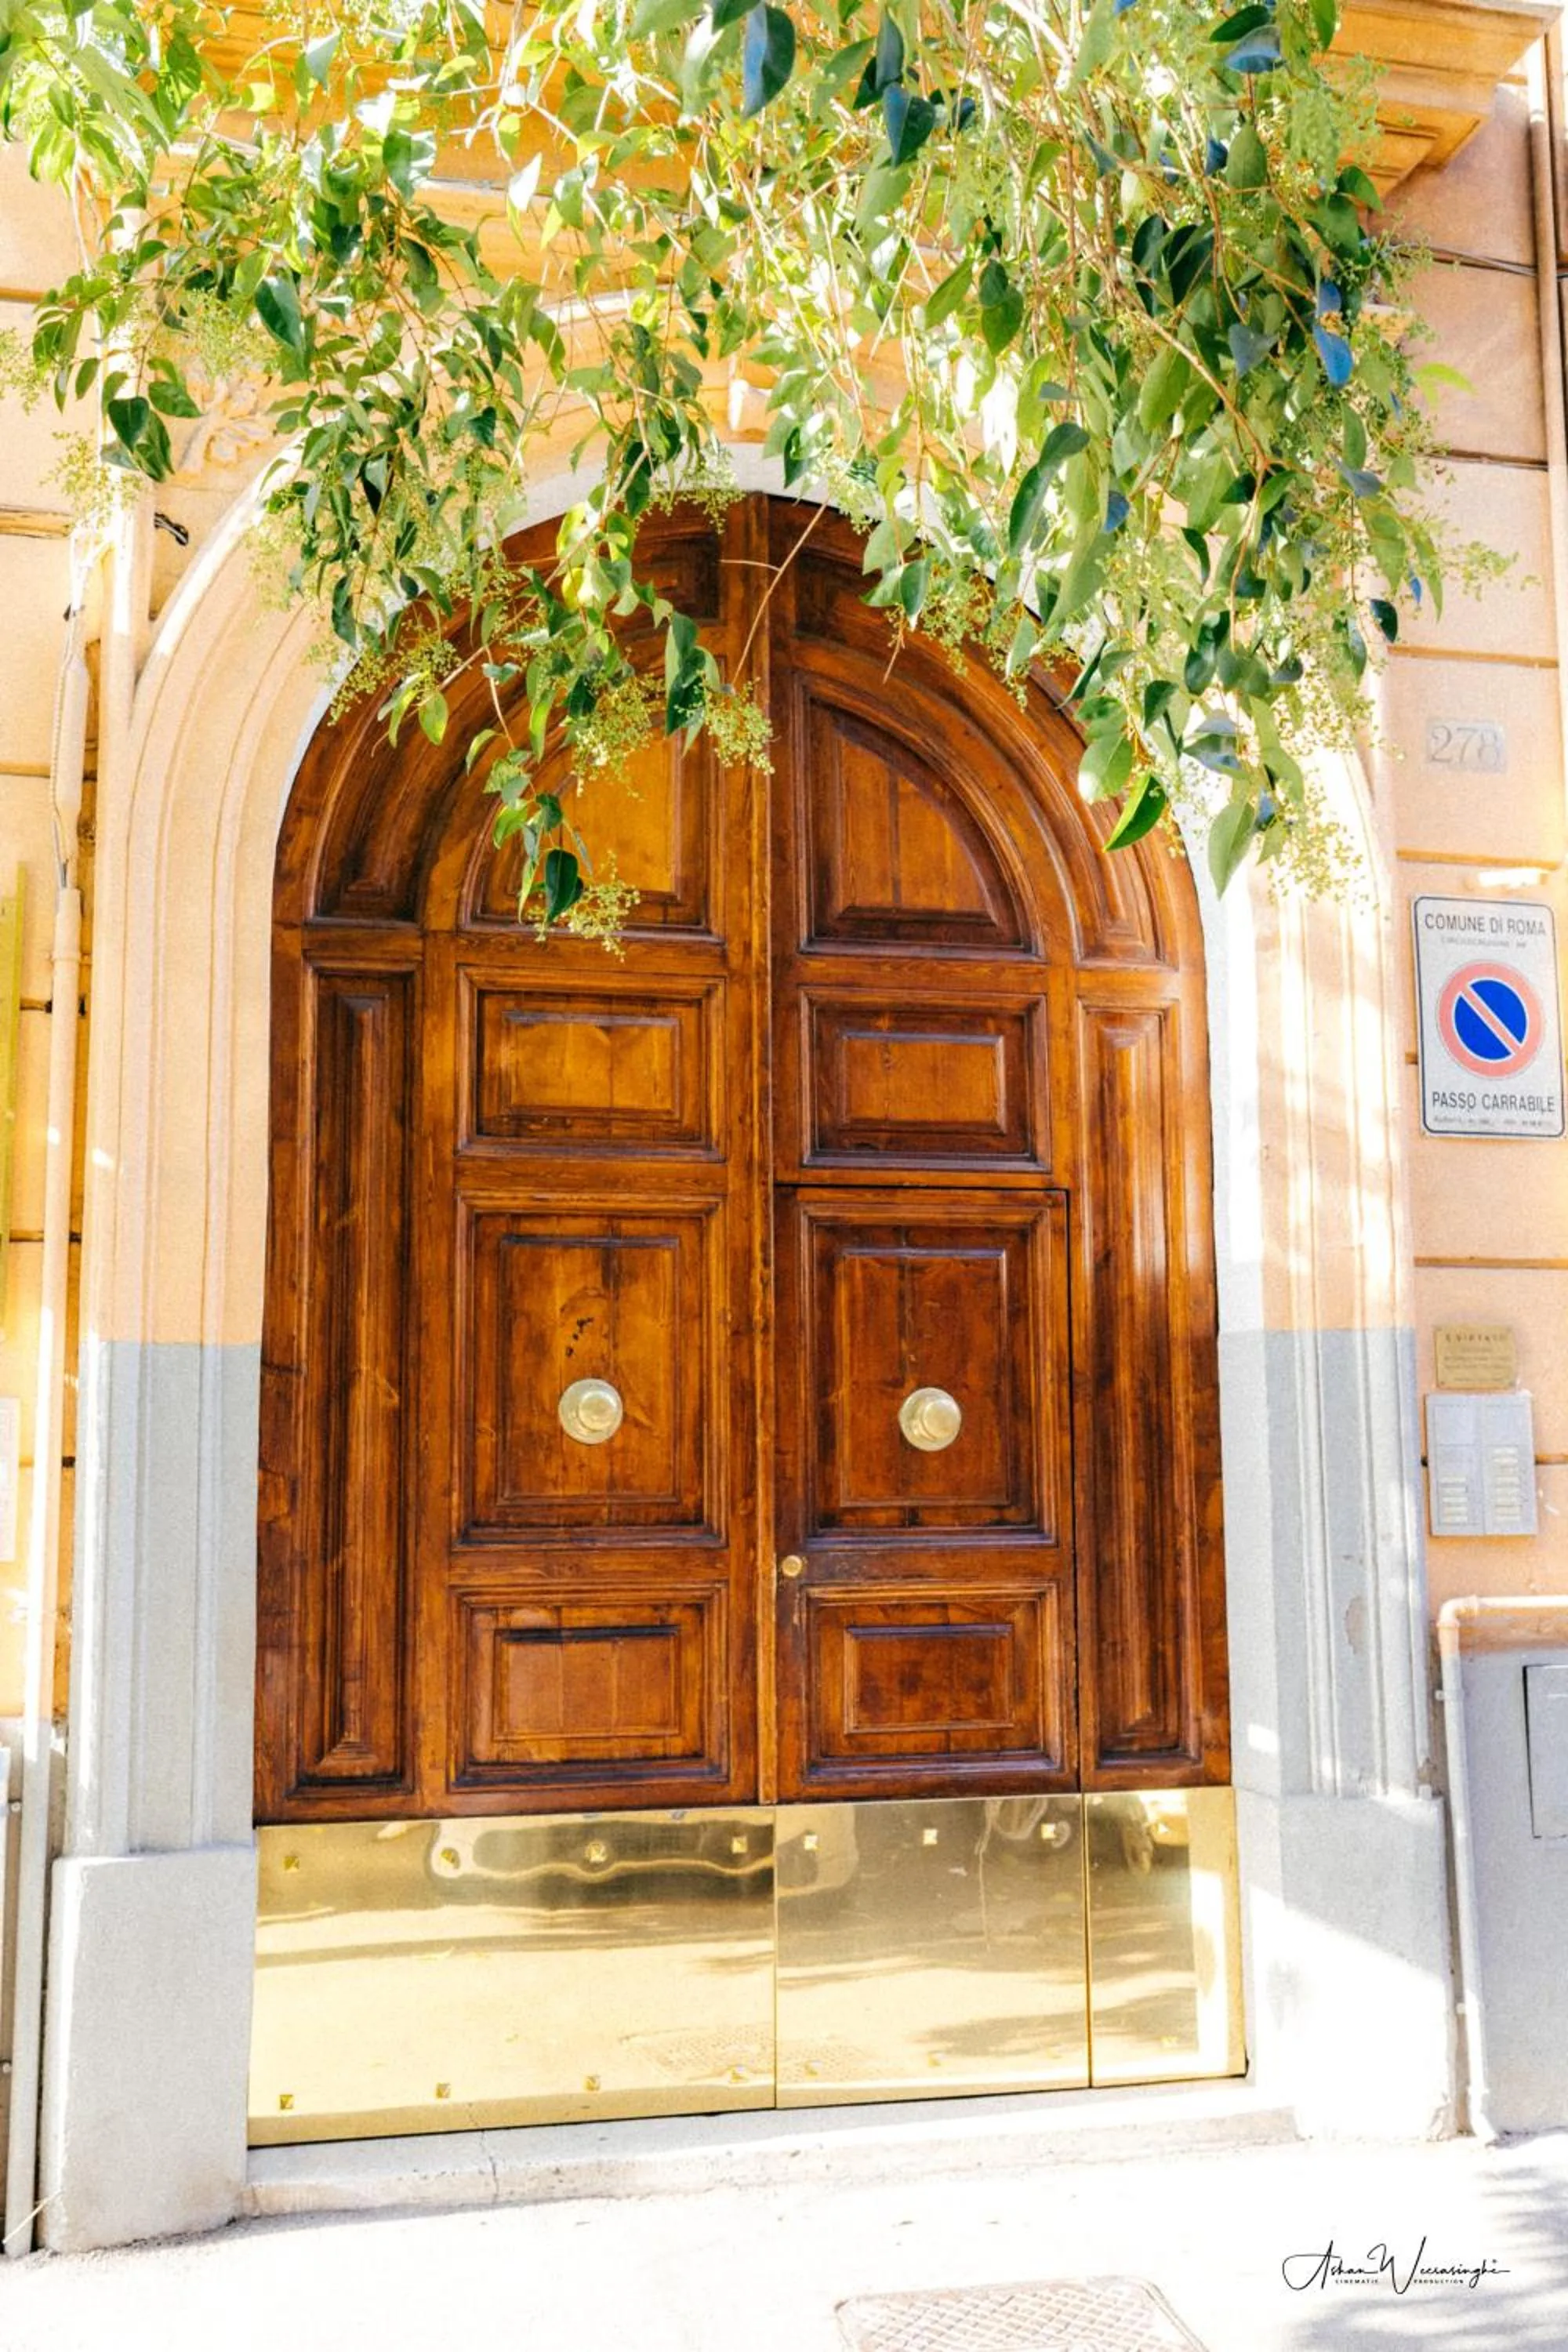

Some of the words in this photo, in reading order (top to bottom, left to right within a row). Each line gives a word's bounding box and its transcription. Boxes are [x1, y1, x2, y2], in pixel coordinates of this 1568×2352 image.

[1430, 725, 1501, 769] 278
[1425, 913, 1485, 933] COMUNE
[1490, 916, 1503, 931] DI
[1508, 917, 1547, 936] ROMA
[1432, 1091, 1476, 1109] PASSO
[1481, 1094, 1555, 1112] CARRABILE
